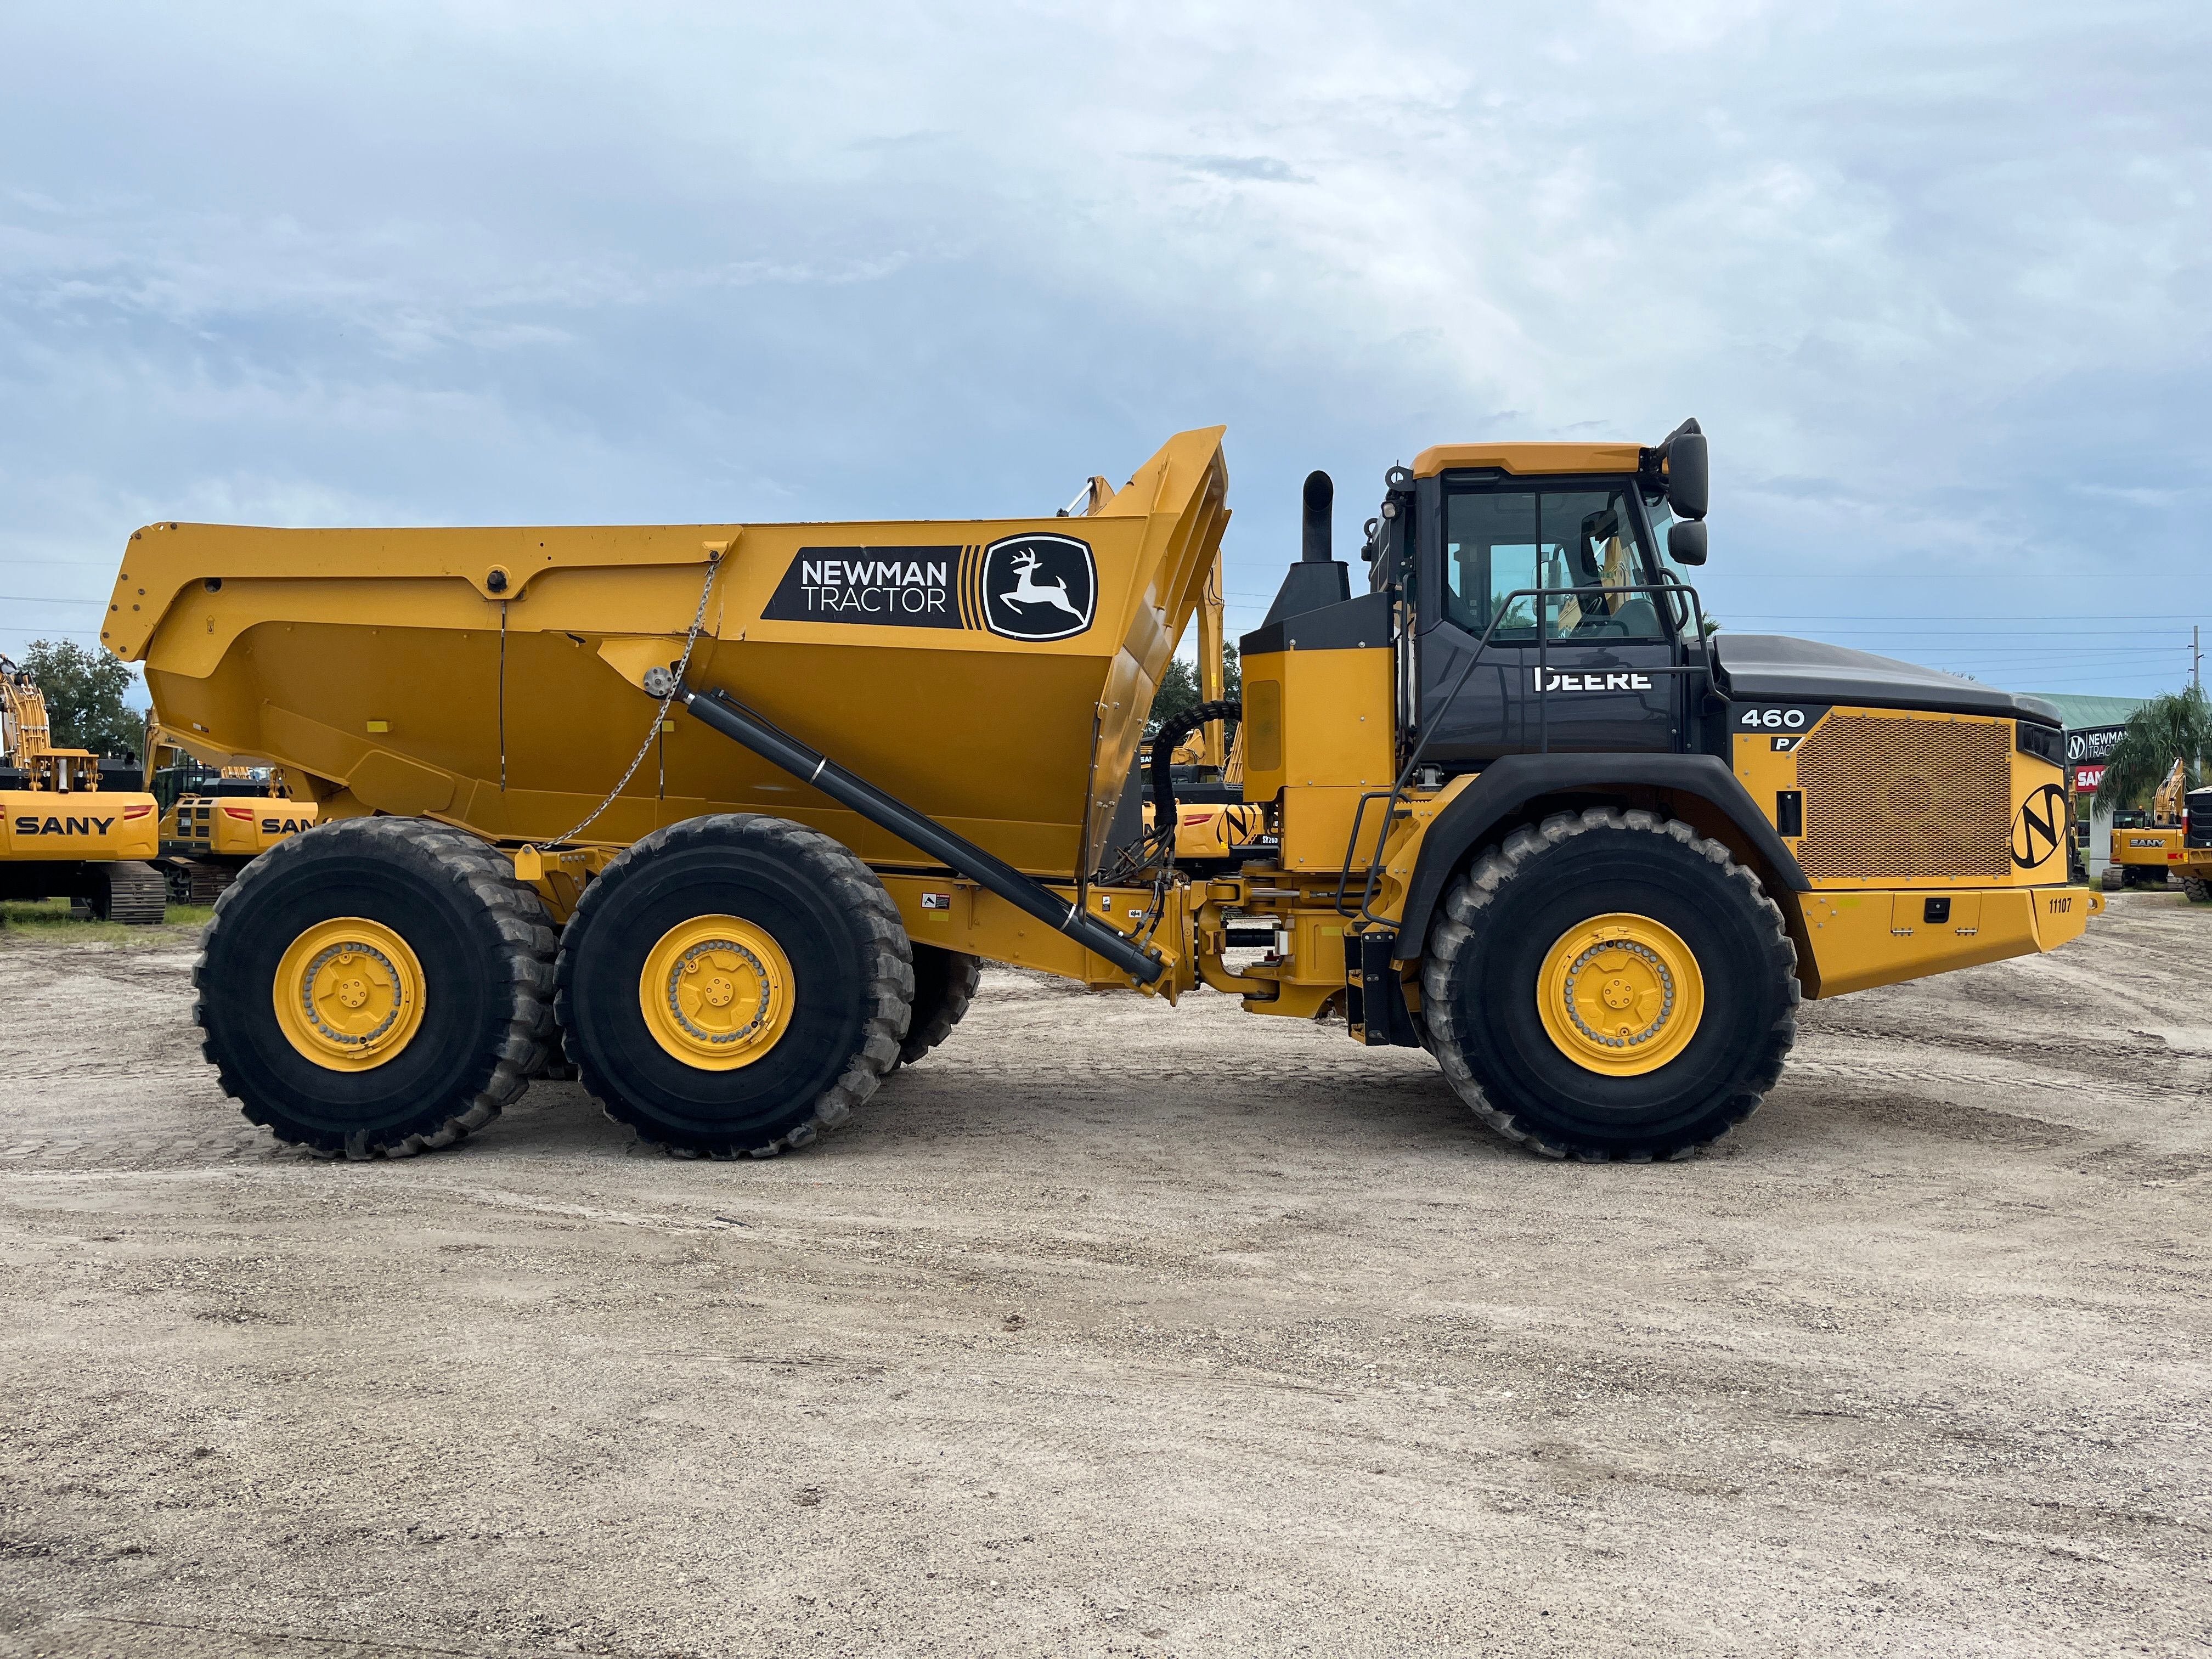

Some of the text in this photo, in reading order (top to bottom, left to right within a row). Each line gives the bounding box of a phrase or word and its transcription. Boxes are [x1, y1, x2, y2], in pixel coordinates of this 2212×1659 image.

[802, 560, 946, 586] NEWMAN
[800, 586, 946, 613] TRACTOR
[1534, 667, 1652, 691] DEERE
[1741, 709, 1805, 727] 460
[2089, 731, 2129, 746] NEWMA
[2088, 744, 2115, 758] TRACT
[2078, 771, 2104, 786] SAN
[15, 816, 115, 836] SANY
[262, 819, 315, 834] SAN
[2130, 839, 2166, 848] SANY
[2049, 898, 2072, 913] 11107
